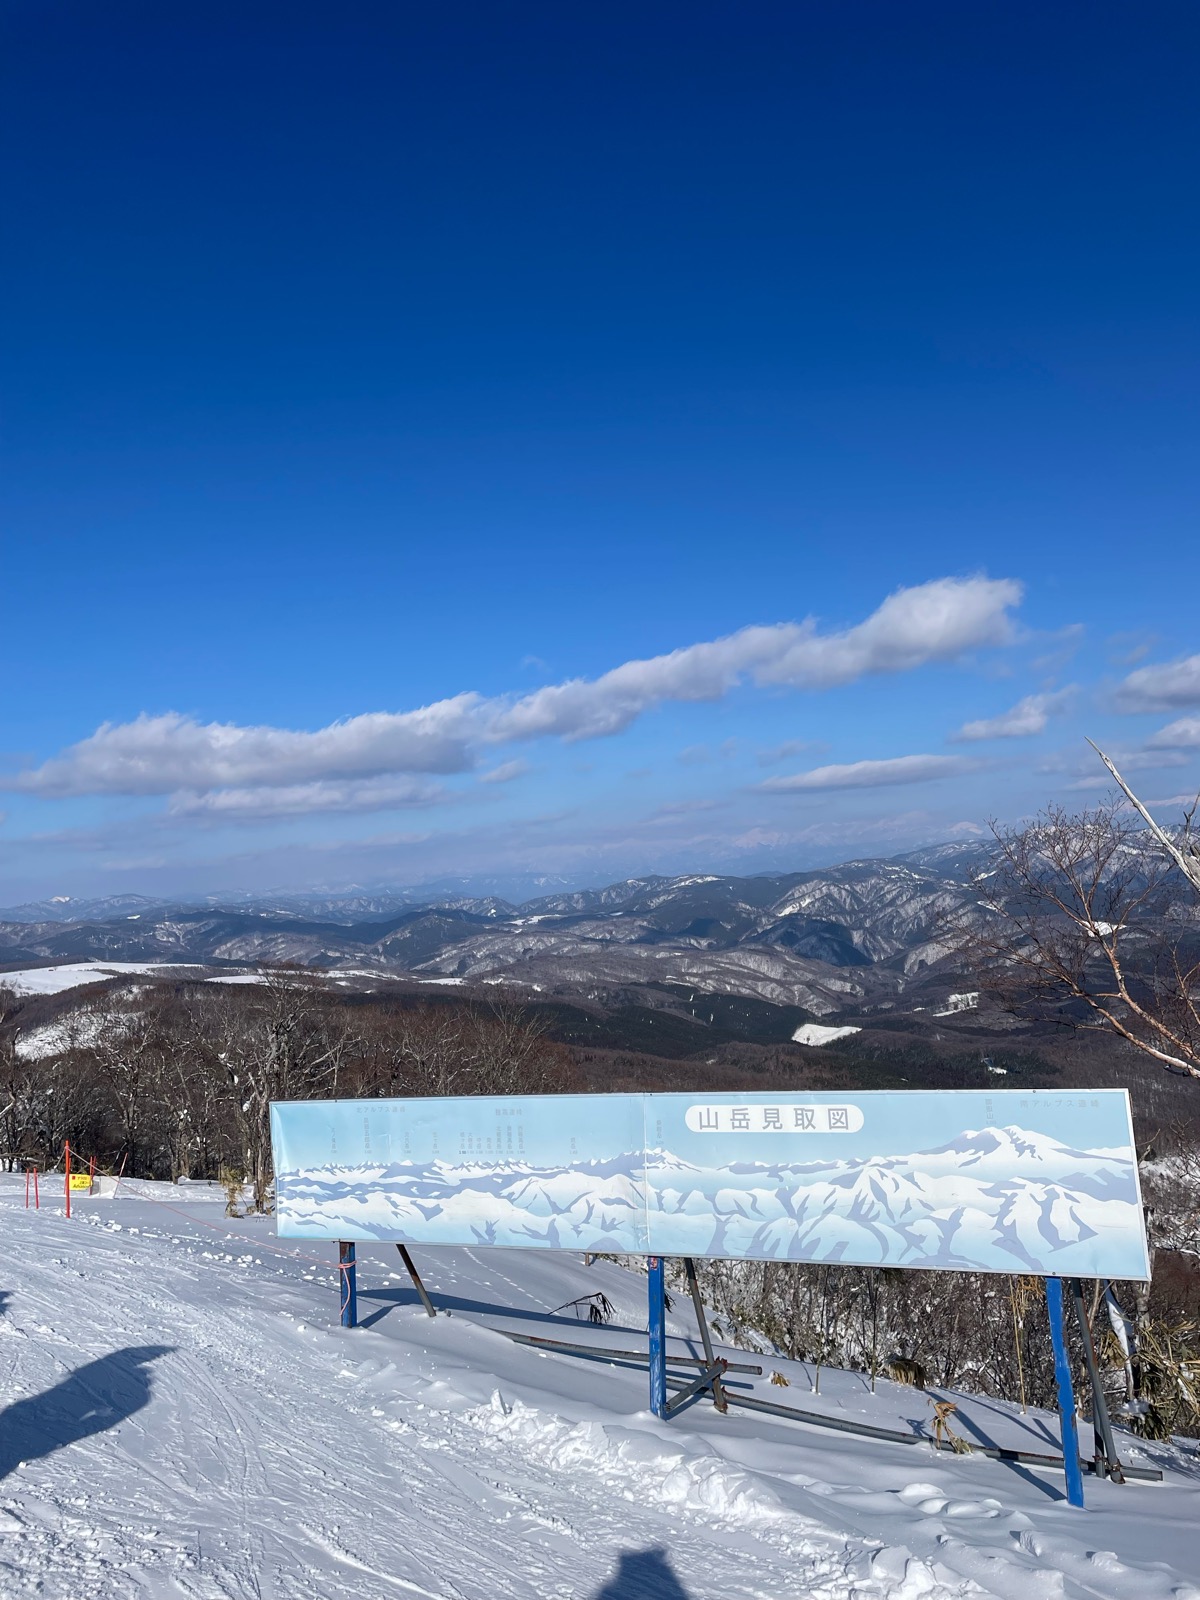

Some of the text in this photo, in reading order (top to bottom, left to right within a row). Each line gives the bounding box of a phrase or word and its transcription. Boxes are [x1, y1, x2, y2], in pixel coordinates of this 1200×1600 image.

[699, 1107, 849, 1130] 山岳見取図
